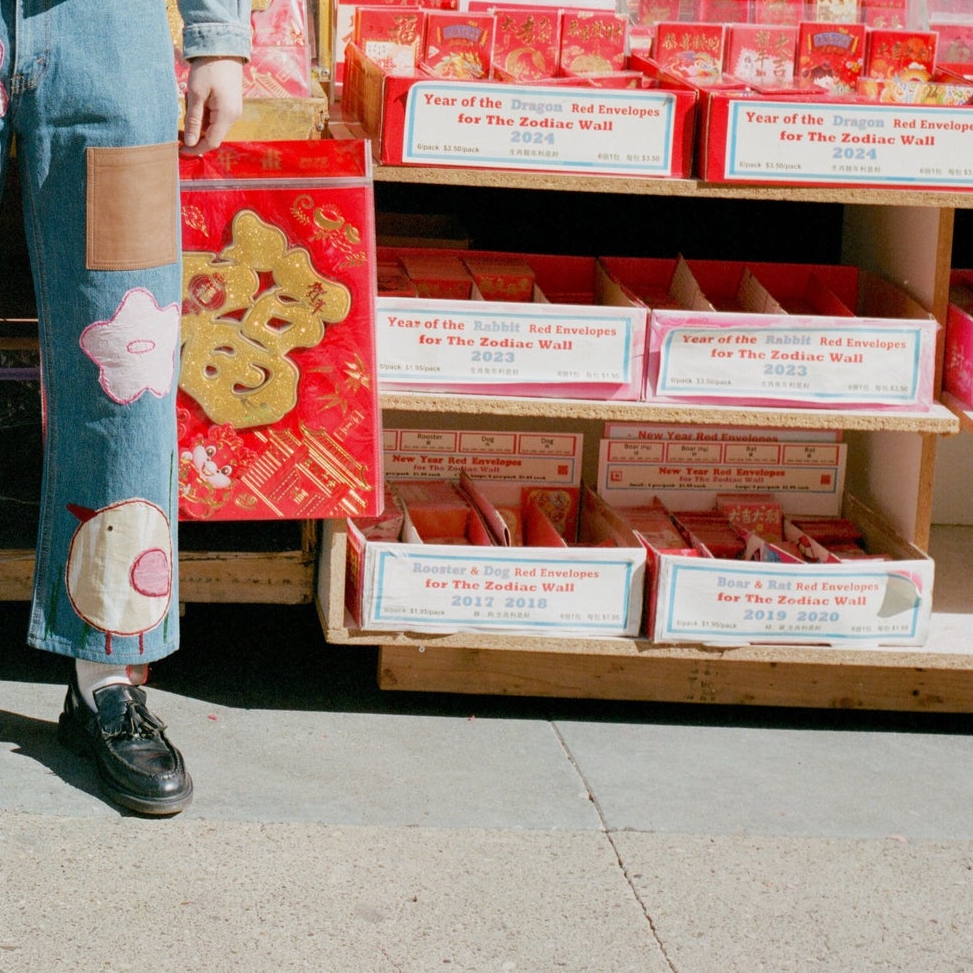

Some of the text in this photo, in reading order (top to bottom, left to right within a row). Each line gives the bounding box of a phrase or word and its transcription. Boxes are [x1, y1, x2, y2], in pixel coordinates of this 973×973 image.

[424, 93, 660, 118] Year of the Dragon Red Envelopes
[457, 113, 614, 132] for The Zodiac Wall
[745, 111, 973, 132] Year of the Dragon Red Envelope
[510, 130, 556, 145] 2024
[779, 130, 936, 146] for The Zodiac Wall
[832, 147, 877, 160] 2024
[387, 316, 618, 338] Year of the Rabbit Red Envelopes
[418, 334, 573, 351] for The Zodiac Wall
[682, 334, 907, 350] Year of the Rabbit Red Envelopes
[471, 350, 516, 364] 2023
[710, 348, 864, 364] for The Zodiac Wall
[763, 363, 808, 377] 2023
[481, 436, 495, 444] Dog
[540, 437, 555, 446] Dog
[638, 430, 779, 443] New Year Red Envelopes
[392, 454, 523, 468] New Year Red Envelopes
[658, 467, 786, 478] New Year Red Envelopes
[412, 561, 600, 580] Rooster & Dog Red Envelopes
[425, 578, 575, 593] for The Zodiac Wall
[717, 576, 880, 593] Boar & Rat Red Envelopes
[451, 594, 548, 610] 2017 2018
[717, 592, 867, 607] for The Zodiac Wall
[743, 608, 840, 623] 2019 2020
